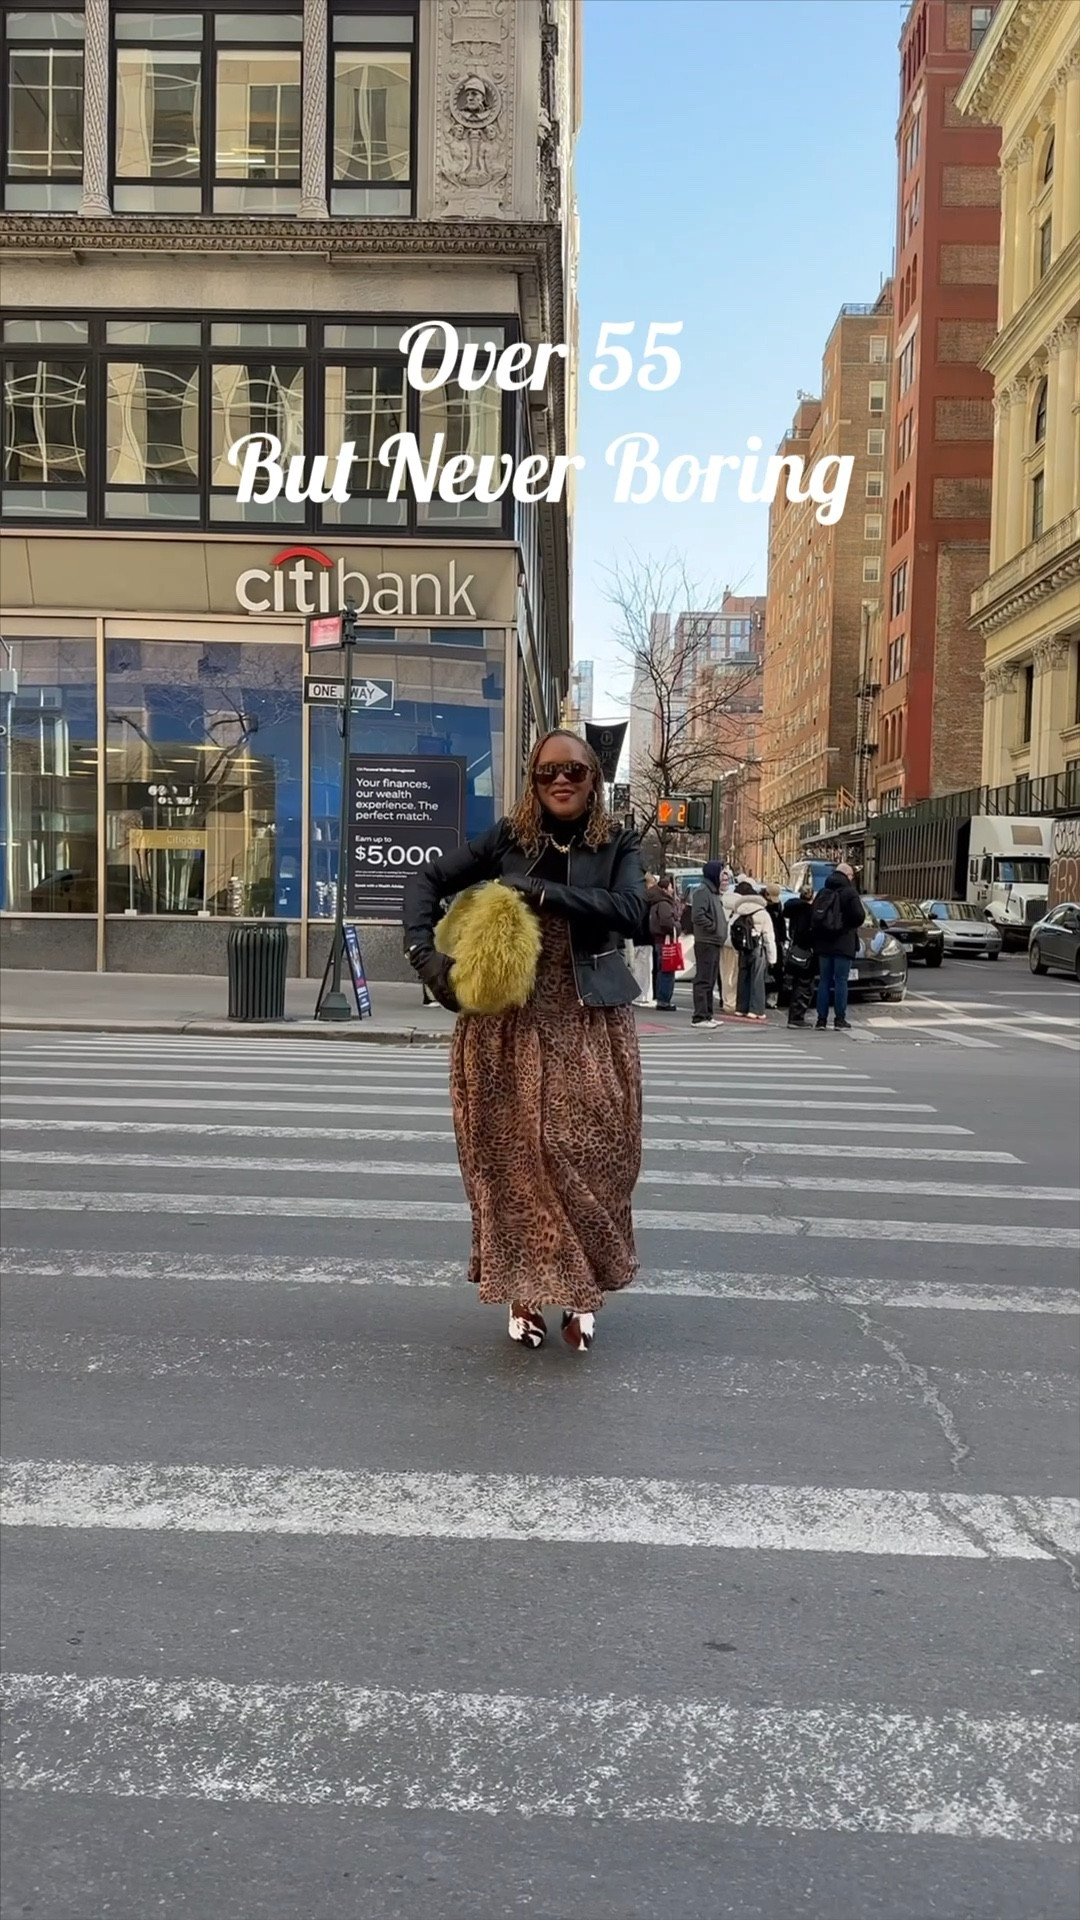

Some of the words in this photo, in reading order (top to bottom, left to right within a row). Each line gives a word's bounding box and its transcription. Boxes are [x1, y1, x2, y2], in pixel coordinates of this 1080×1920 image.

[235, 556, 477, 615] citibank
[313, 685, 337, 697] ONE
[356, 778, 380, 788] Your
[382, 778, 431, 790] finances,
[355, 790, 376, 798] our
[376, 789, 412, 799] wealth
[355, 801, 416, 811] experience.
[418, 801, 439, 811] The
[355, 811, 394, 821] perfect
[396, 811, 433, 821] match.
[677, 804, 686, 822] 2
[373, 836, 383, 844] up
